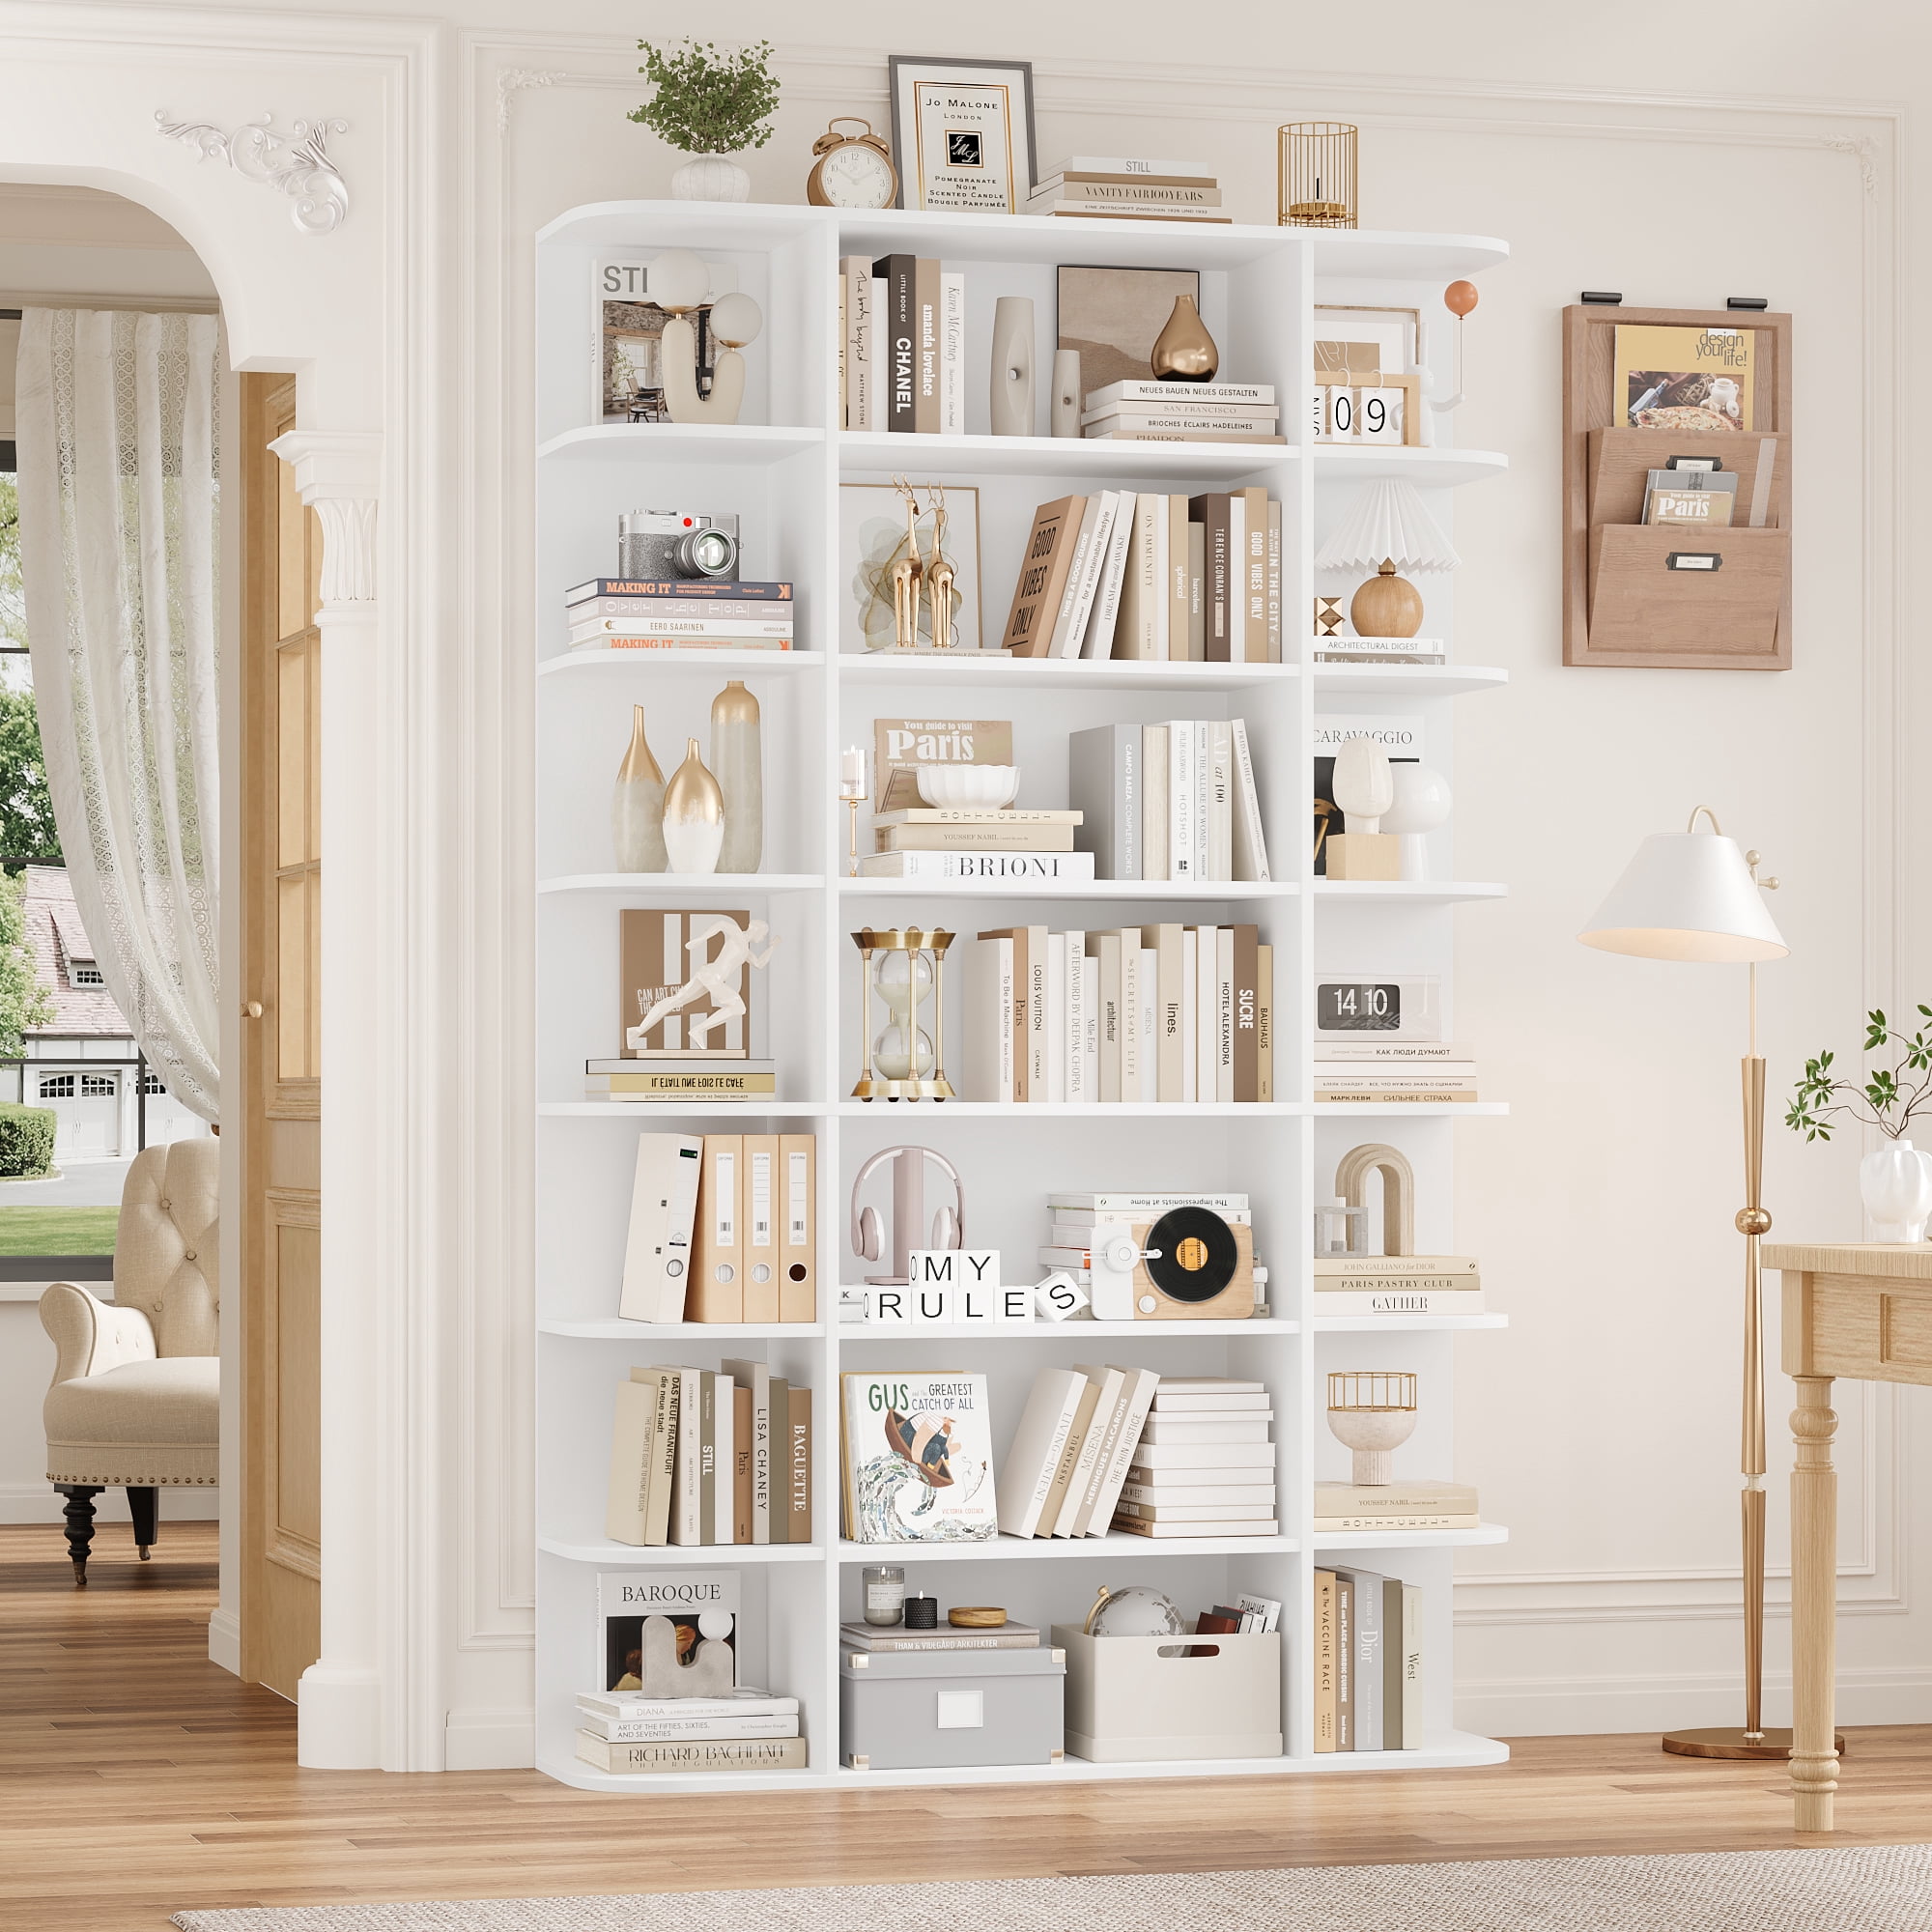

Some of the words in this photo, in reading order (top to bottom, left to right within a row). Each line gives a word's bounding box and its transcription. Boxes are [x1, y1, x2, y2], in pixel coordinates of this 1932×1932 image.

[1125, 161, 1151, 173] STILL
[948, 287, 960, 312] Karen
[923, 304, 936, 348] amanda
[944, 316, 960, 362] McCartney
[1700, 329, 1744, 350] design
[1695, 344, 1725, 360] your
[1724, 349, 1747, 367] life!
[895, 337, 912, 413] CHANEL
[923, 352, 936, 397] lovelace
[1219, 388, 1259, 397] GESTALTEN
[1183, 419, 1209, 428] ÉCLAIRS
[1185, 406, 1236, 414] FRANCISCO
[1657, 497, 1710, 517] Paris
[1031, 526, 1057, 559] GOOD
[1078, 532, 1090, 558] GUIDE
[1088, 540, 1102, 582] sustainable
[1097, 511, 1110, 539] lifestyle
[1215, 528, 1225, 565] TERENCE
[1251, 531, 1263, 556] GOOD
[1268, 553, 1279, 567] IN
[606, 582, 656, 594] MAKING
[658, 582, 671, 594] IT
[1020, 565, 1048, 599] VIBES
[1104, 589, 1116, 621] DREAM
[1115, 534, 1125, 563] AWAKE
[1175, 565, 1186, 599] spherical
[1215, 566, 1225, 601] CONRAN'S
[1251, 564, 1263, 591] VIBES
[1268, 572, 1279, 597] THE
[1192, 578, 1201, 614] barcelona
[1251, 597, 1263, 620] ONLY
[650, 622, 668, 631] EERO
[669, 622, 704, 632] SAARINEN
[1011, 605, 1037, 638] ONLY
[1268, 602, 1279, 632] CITY
[610, 639, 659, 649] MAKING
[662, 639, 673, 649] IT
[1327, 641, 1389, 650] ARCHITECTURAL
[1391, 642, 1419, 651] DIGEST
[886, 729, 975, 761] Paris
[1237, 730, 1247, 755] FRIDA
[1124, 744, 1133, 774] CAMPO
[1124, 805, 1133, 844] COMPLETE
[1179, 794, 1187, 847] HOTSHOT
[957, 857, 1061, 877] BRIONI
[1034, 964, 1042, 991] LOUIS
[1071, 943, 1080, 1001] AFTERWORD
[1015, 999, 1026, 1027] Paris
[1034, 993, 1042, 1031] VUITTON
[1071, 1004, 1080, 1016] BY
[1239, 989, 1254, 1029] SUCRE
[1333, 988, 1357, 1015] 14
[1364, 988, 1388, 1015] 10
[1087, 1019, 1095, 1036] Mile
[1106, 1001, 1116, 1042] architectuur
[1167, 1003, 1179, 1037] lines.
[1260, 1008, 1268, 1049] BAUHAUS
[1071, 1018, 1080, 1053] DEEPAK
[1087, 1037, 1095, 1053] End
[1071, 1055, 1080, 1093] CHOPRA
[924, 1256, 991, 1281] MY
[879, 1284, 1075, 1319] RULES
[1372, 1296, 1428, 1309] GATHER
[660, 1376, 668, 1388] die
[670, 1377, 680, 1395] DAS
[668, 1397, 678, 1422] NEUE
[868, 1383, 909, 1412] GUS
[928, 1383, 973, 1396] GREATEST
[911, 1398, 941, 1411] CATCH
[944, 1398, 955, 1410] OF
[958, 1398, 975, 1410] ALL
[657, 1412, 666, 1434] stadt
[757, 1408, 766, 1441] LISA
[665, 1424, 676, 1476] FRANKFURT
[702, 1445, 713, 1476] STILL
[1057, 1433, 1080, 1485] INSTANBUL
[1086, 1452, 1109, 1506] MERINGUES
[1104, 1398, 1128, 1450] MACARONS
[1110, 1468, 1122, 1485] THE
[1117, 1447, 1130, 1467] THIN
[1124, 1412, 1142, 1447] JUSTICE
[738, 1451, 749, 1476] Paris
[793, 1424, 806, 1512] BAGUETTE
[757, 1449, 767, 1510] CHANEY
[1343, 1519, 1449, 1527] BOTTICELLI
[621, 1584, 722, 1604] BAROQUE
[895, 1641, 914, 1650] THAM
[956, 1639, 998, 1648] ARKITEKTER
[1321, 1610, 1330, 1659] VACCINE
[1360, 1631, 1378, 1663] Dior
[1321, 1664, 1330, 1692] RACE
[1407, 1653, 1419, 1681] West
[637, 1708, 665, 1717] DIANA
[628, 1747, 699, 1763] RICHARD
